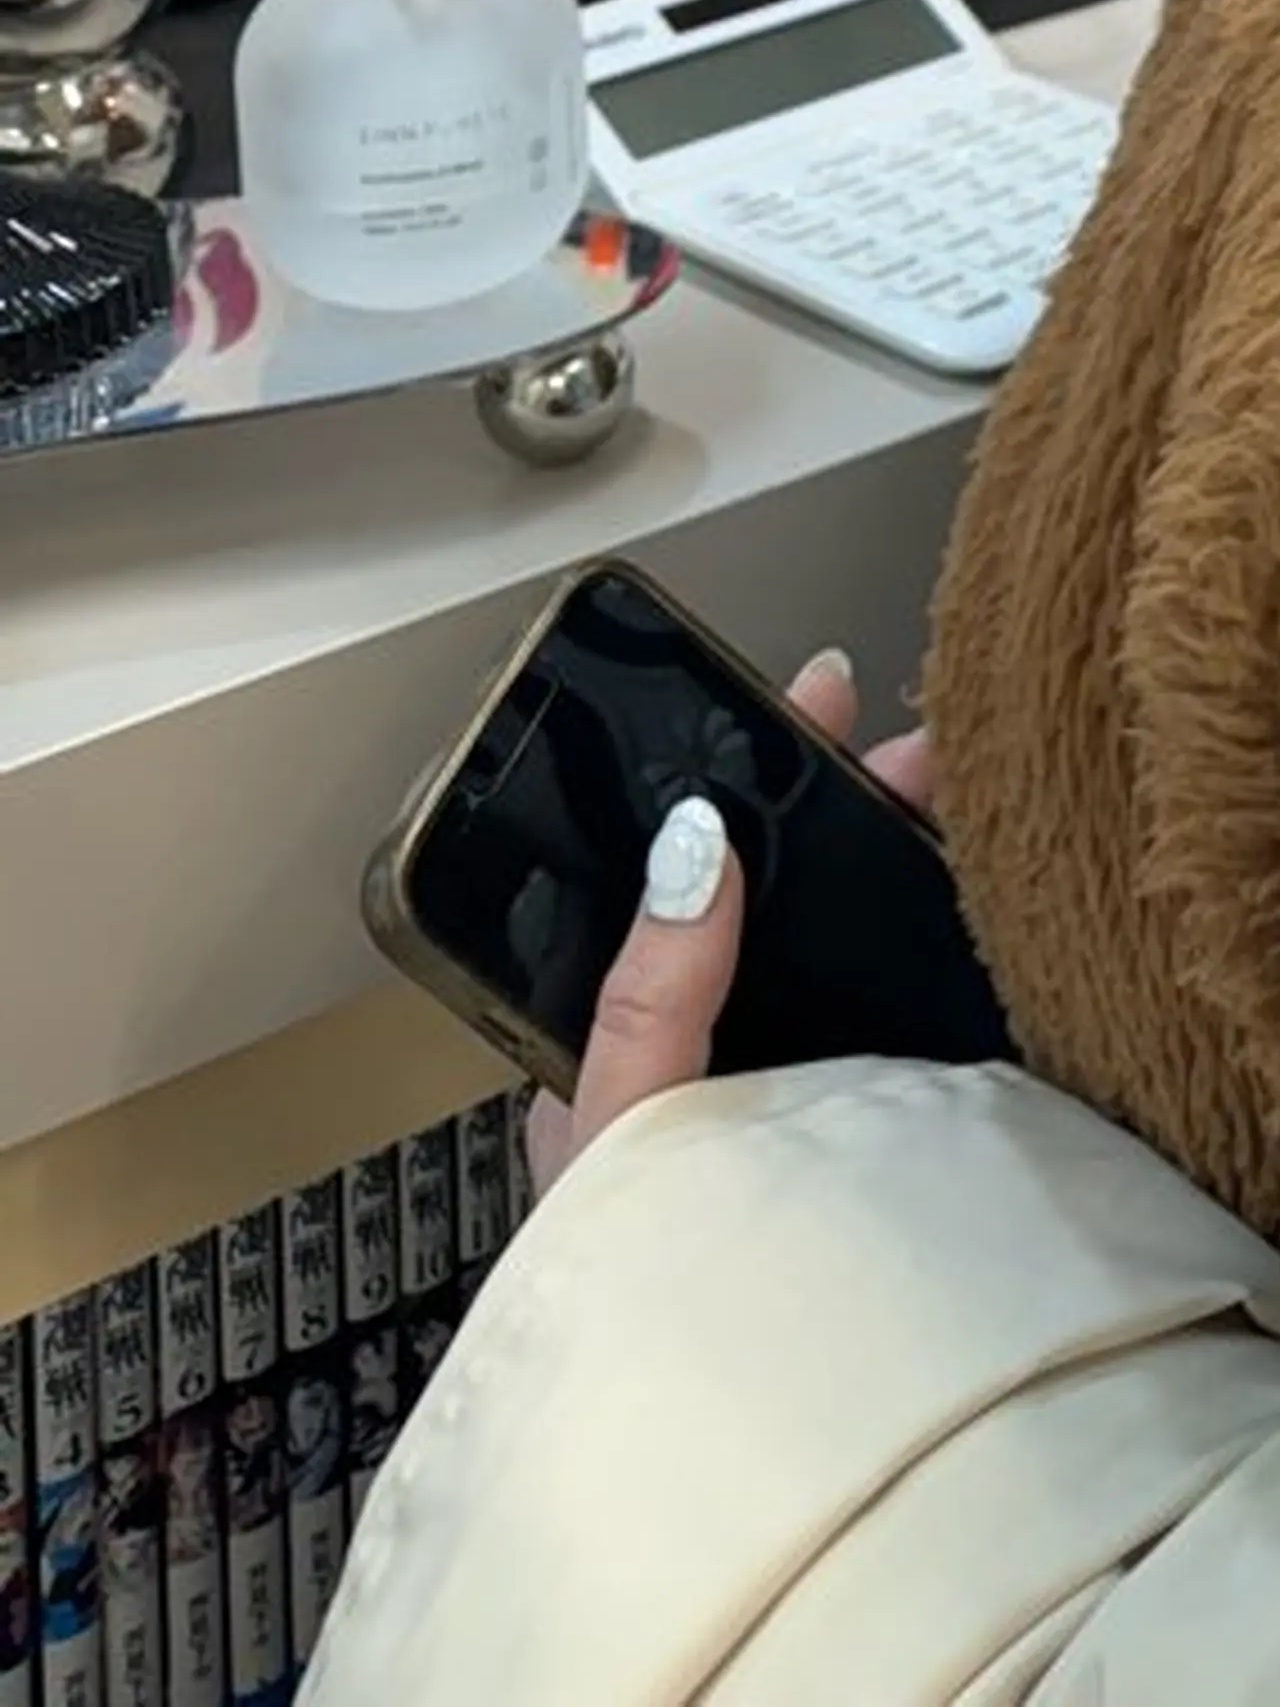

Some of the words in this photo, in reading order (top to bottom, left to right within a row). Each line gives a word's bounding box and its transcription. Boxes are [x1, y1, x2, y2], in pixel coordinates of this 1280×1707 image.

[361, 1273, 389, 1311] 9
[300, 1304, 329, 1340] 8
[238, 1332, 266, 1371] 7
[177, 1367, 206, 1399] 6
[112, 1392, 142, 1433] 5
